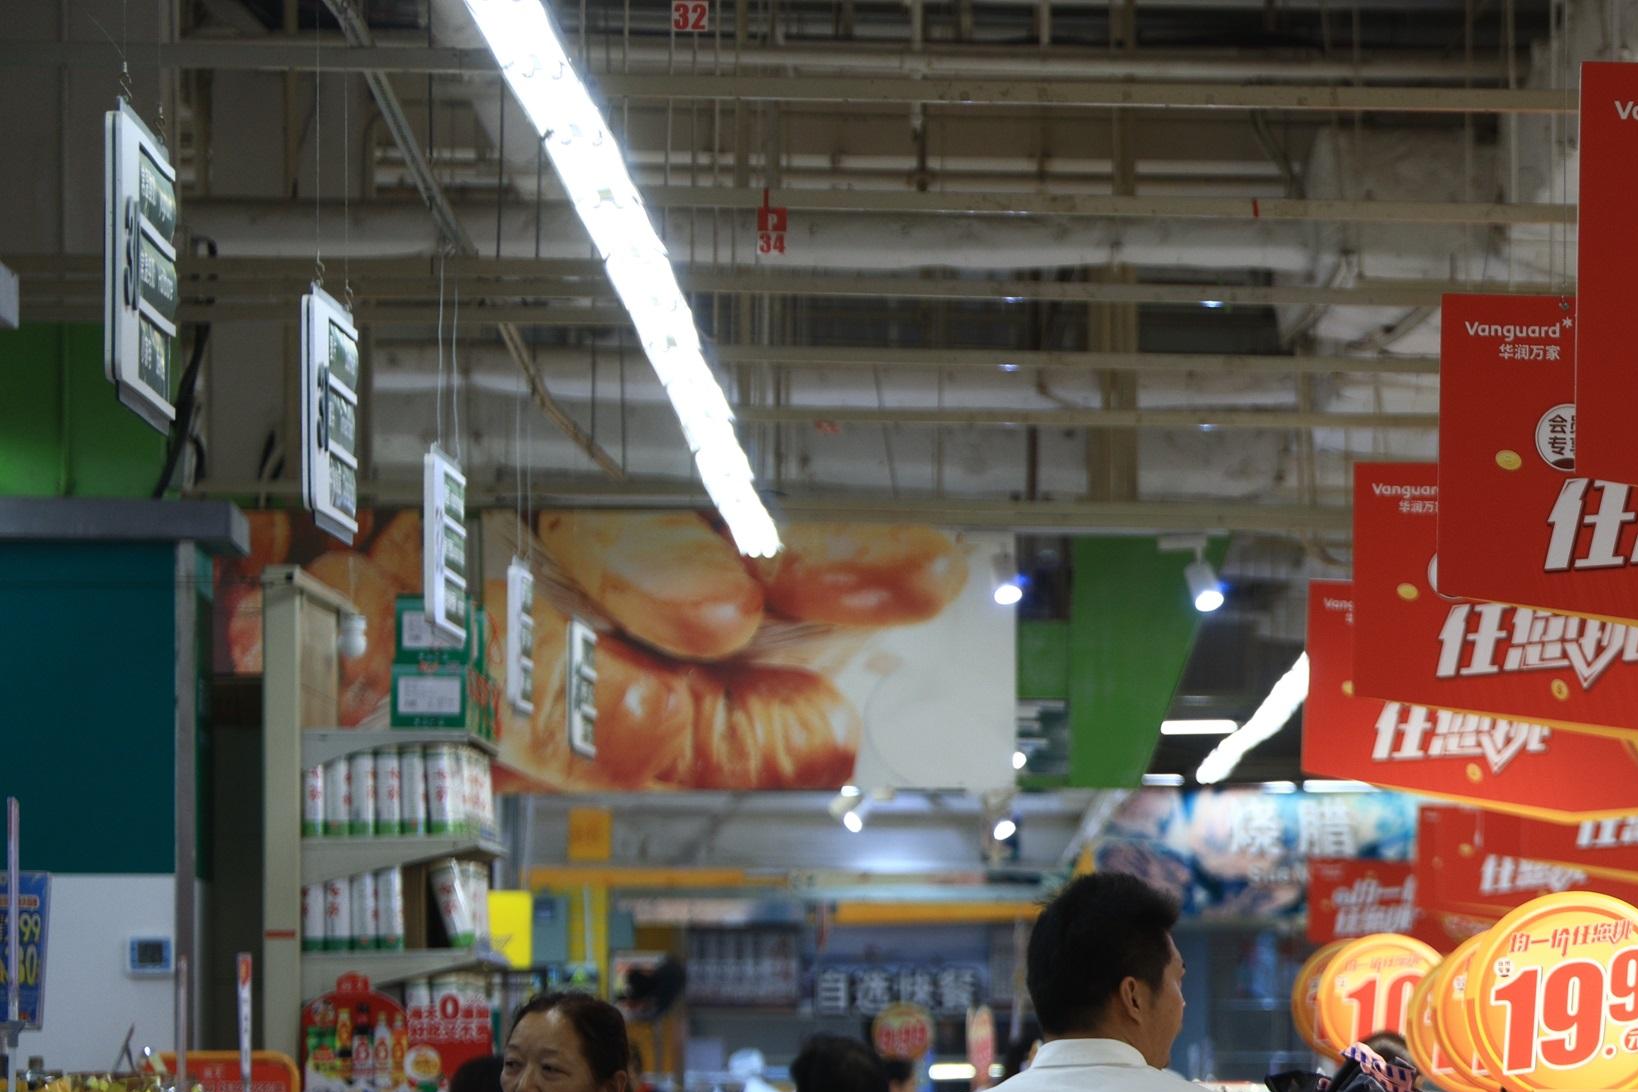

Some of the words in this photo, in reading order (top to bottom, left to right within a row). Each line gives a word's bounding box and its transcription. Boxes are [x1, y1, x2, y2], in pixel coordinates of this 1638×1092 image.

[674, 3, 706, 30] 32
[758, 233, 786, 254] 34
[1465, 321, 1561, 341] Vanguard
[1499, 344, 1561, 361] 华润万家
[1372, 483, 1438, 498] Vanguar
[1399, 501, 1438, 513] 华润万
[1510, 919, 1634, 957] 均一价任您挑
